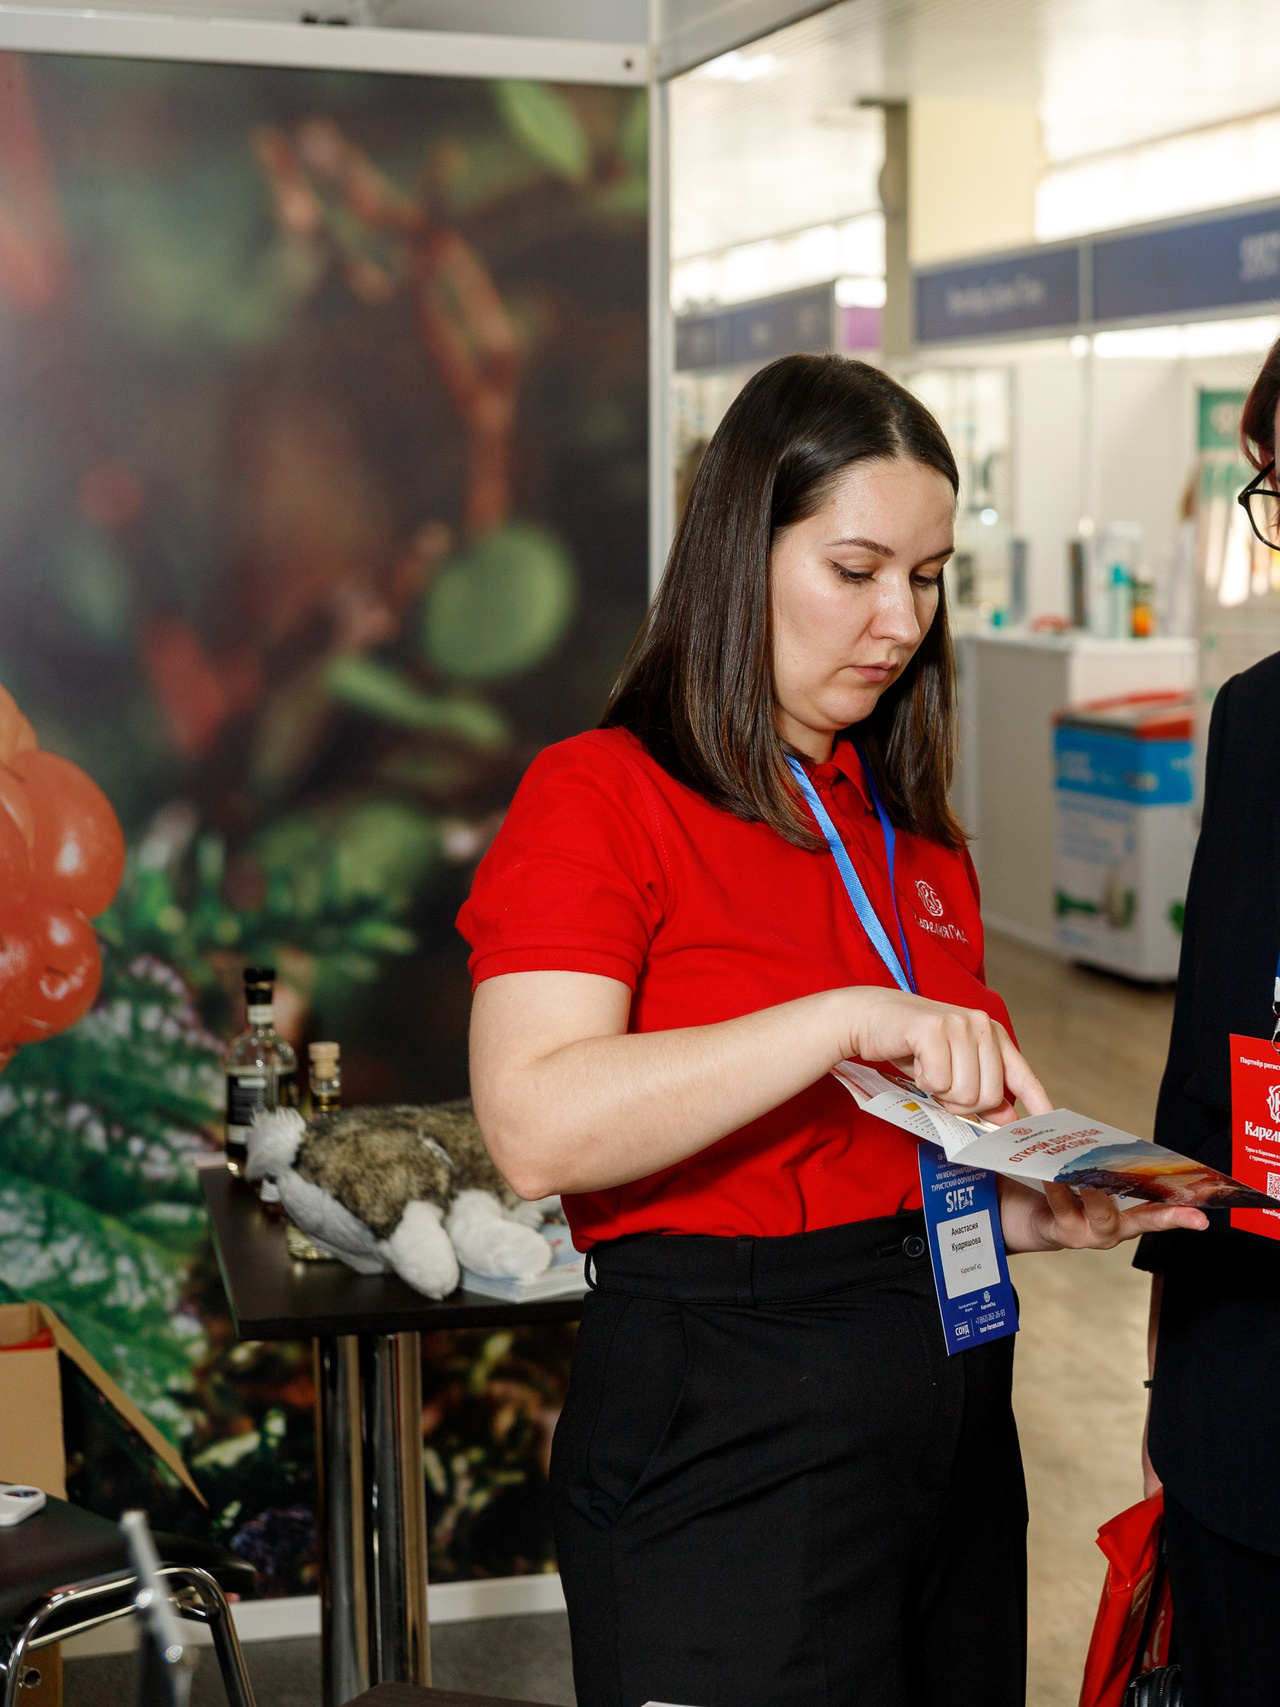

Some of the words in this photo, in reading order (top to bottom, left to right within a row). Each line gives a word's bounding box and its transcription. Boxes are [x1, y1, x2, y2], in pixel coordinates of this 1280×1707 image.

[1240, 1056, 1263, 1069] Партнёр
[1009, 1140, 1053, 1162] ОТКРОЙ
[951, 1222, 979, 1236] Анастасия
[951, 1237, 981, 1252] Кудряшова
